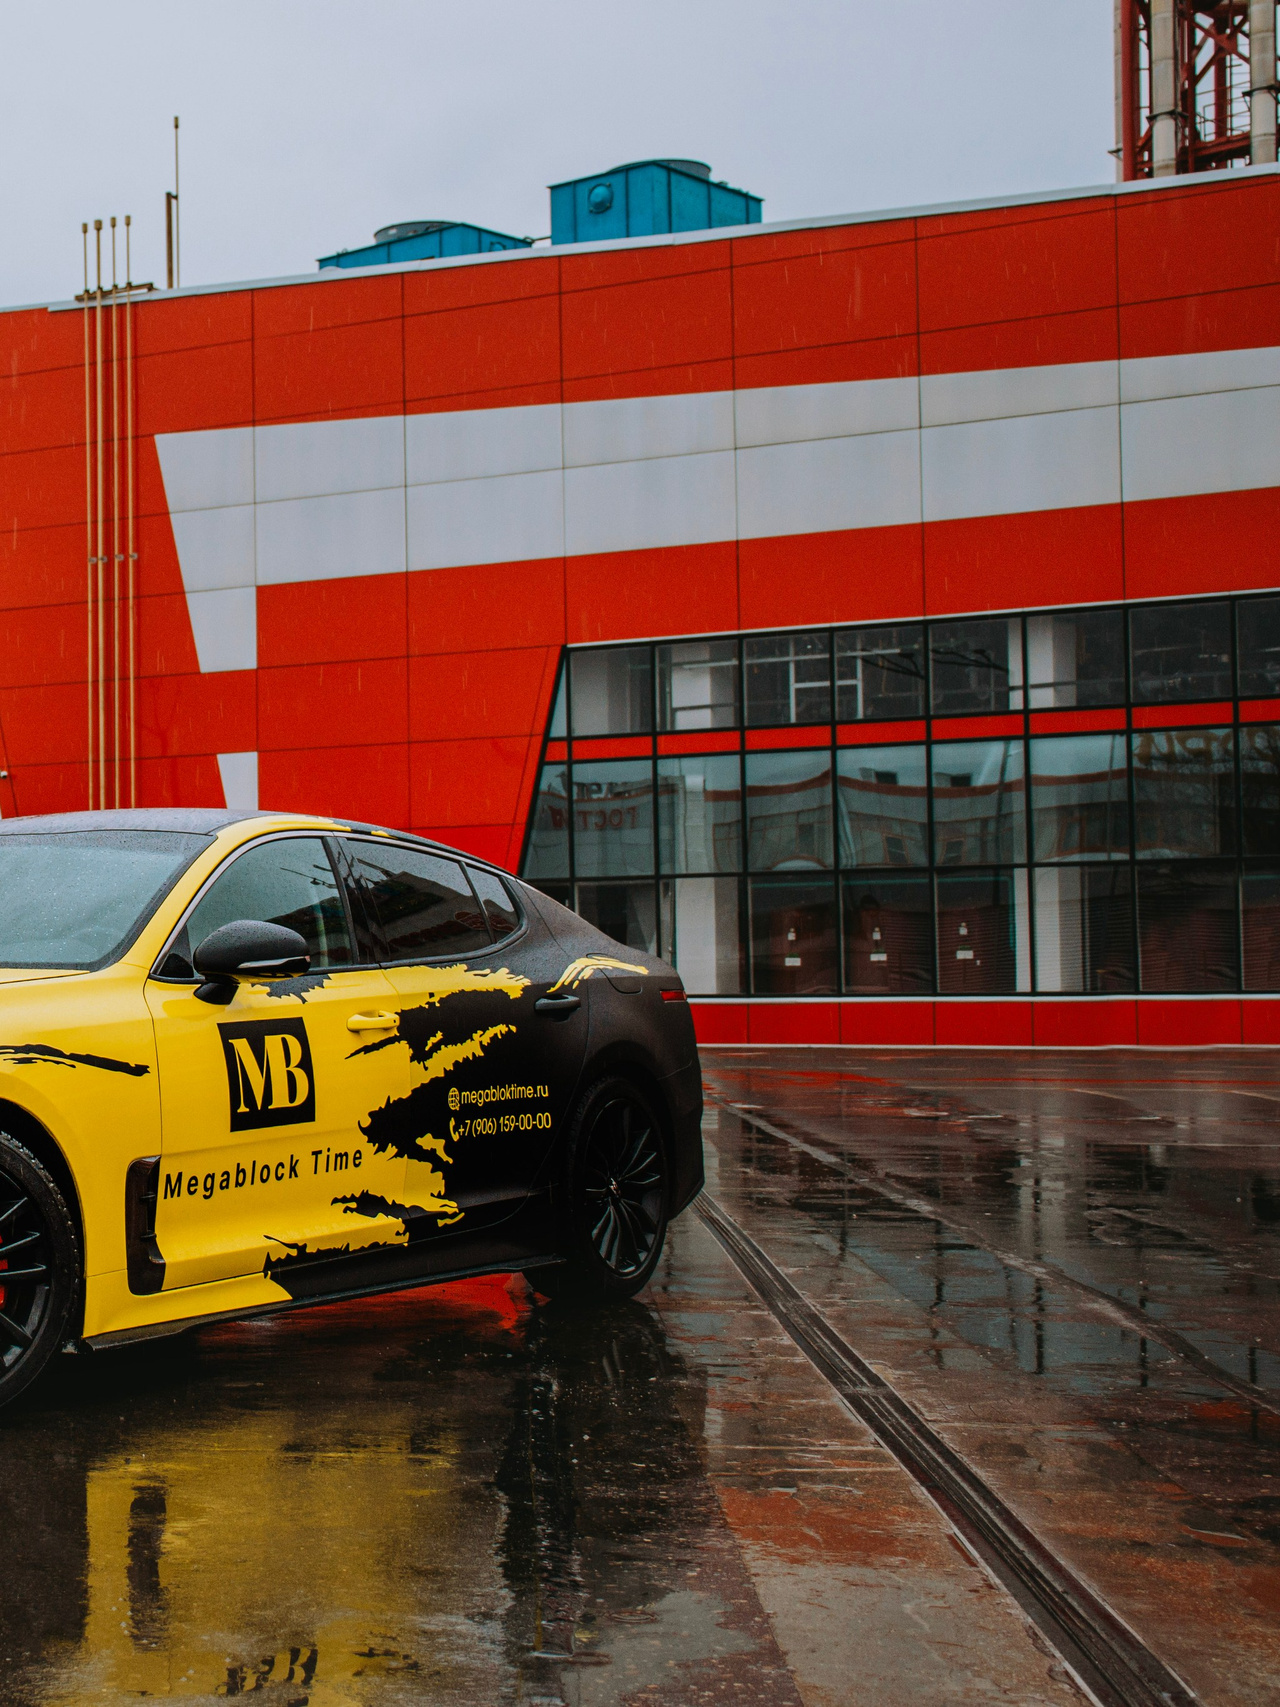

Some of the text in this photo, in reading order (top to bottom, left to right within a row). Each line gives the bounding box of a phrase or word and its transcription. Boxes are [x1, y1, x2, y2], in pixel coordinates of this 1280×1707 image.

[228, 1034, 309, 1113] MB
[461, 1084, 549, 1107] megabloktime.ru
[458, 1112, 552, 1138] +7 (906) 159-00-00
[163, 1147, 363, 1200] Megablock Time
